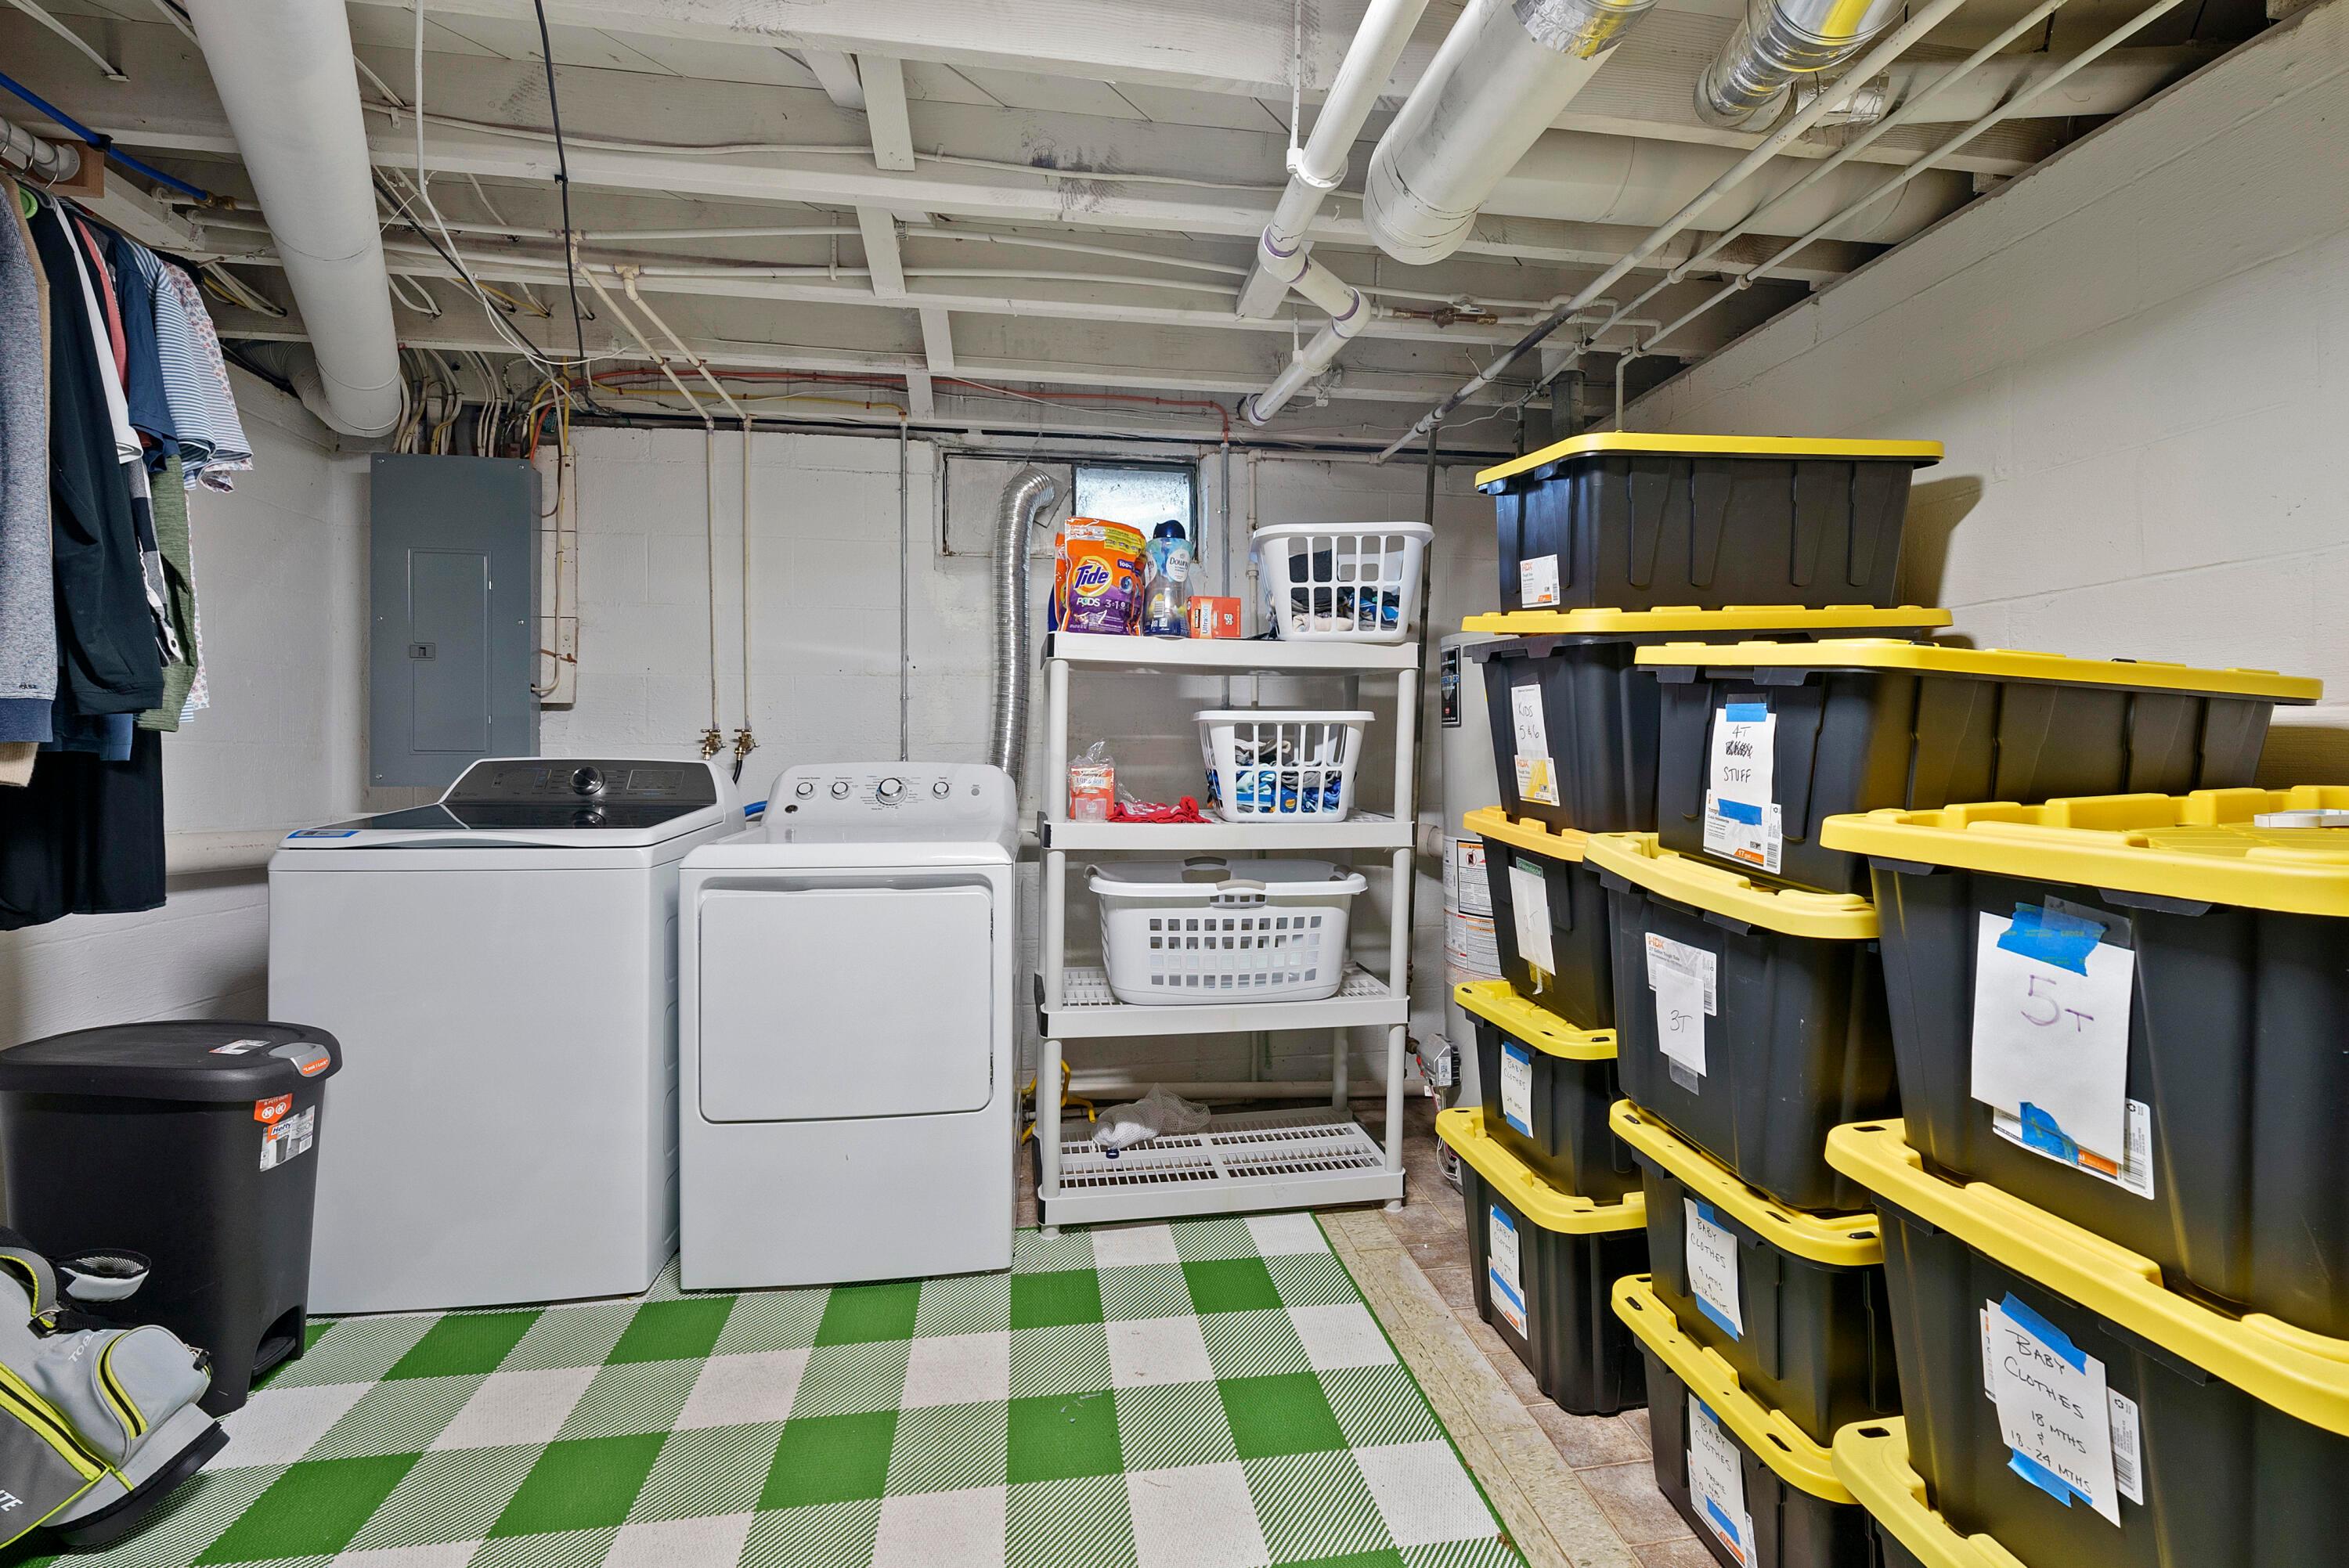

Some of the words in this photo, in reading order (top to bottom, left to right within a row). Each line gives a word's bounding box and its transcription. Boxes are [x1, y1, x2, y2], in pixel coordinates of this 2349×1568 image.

[1170, 557, 1189, 570] Downy
[1073, 564, 1110, 589] Tide
[1076, 597, 1100, 607] PODS
[1518, 701, 1533, 718] KIDS
[1519, 725, 1526, 740] 5
[1532, 724, 1540, 739] 6
[1732, 724, 1752, 739] 4T
[1723, 766, 1752, 784] STUFF
[1648, 936, 1665, 950] HDX
[2021, 975, 2095, 1033] 5T
[1670, 1009, 1693, 1033] 3T
[1506, 1058, 1523, 1075] BABY
[1503, 1068, 1526, 1090] CLOTHES
[272, 1123, 291, 1134] Hefty
[1494, 1220, 1511, 1240] BABY
[1695, 1217, 1717, 1243] BABY
[1493, 1231, 1515, 1259] CLOTHES
[1690, 1232, 1727, 1269] CLOTHES
[1698, 1265, 1704, 1277] 9
[2005, 1329, 2066, 1375] BABY
[2004, 1356, 2084, 1419] CLOTHES
[1698, 1415, 1726, 1449] BABY
[2032, 1410, 2044, 1427] 18
[2050, 1425, 2087, 1454] MTHS
[1694, 1429, 1732, 1473] CLOTHES
[2059, 1464, 2092, 1495] MTHS
